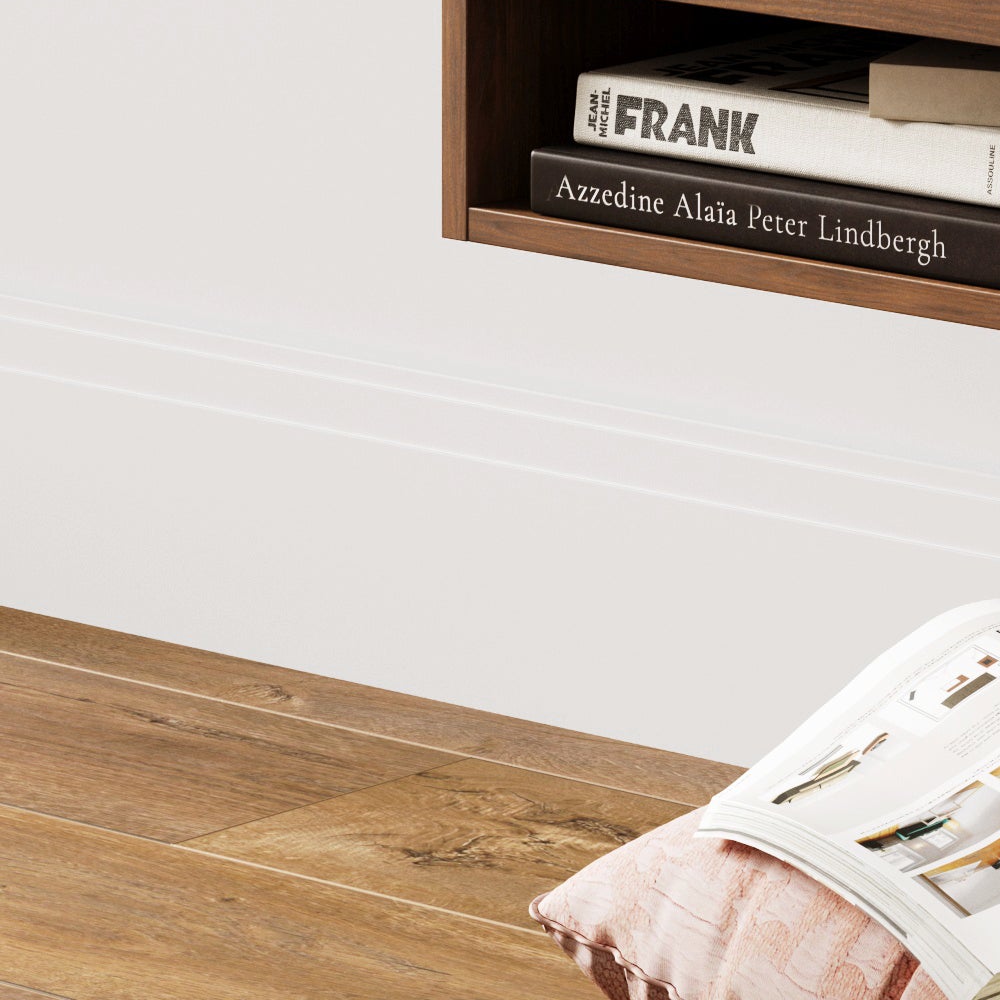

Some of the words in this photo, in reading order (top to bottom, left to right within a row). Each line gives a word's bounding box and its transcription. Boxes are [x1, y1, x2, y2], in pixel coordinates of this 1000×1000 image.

[587, 89, 599, 132] JEAN-
[598, 87, 611, 138] MICHEL
[614, 94, 760, 155] FRANK
[986, 144, 996, 196] ASSOULINE
[555, 174, 665, 215] Azzedine
[673, 192, 738, 226] Alaïa
[747, 204, 808, 238] Peter
[818, 214, 947, 266] Lindbergh
